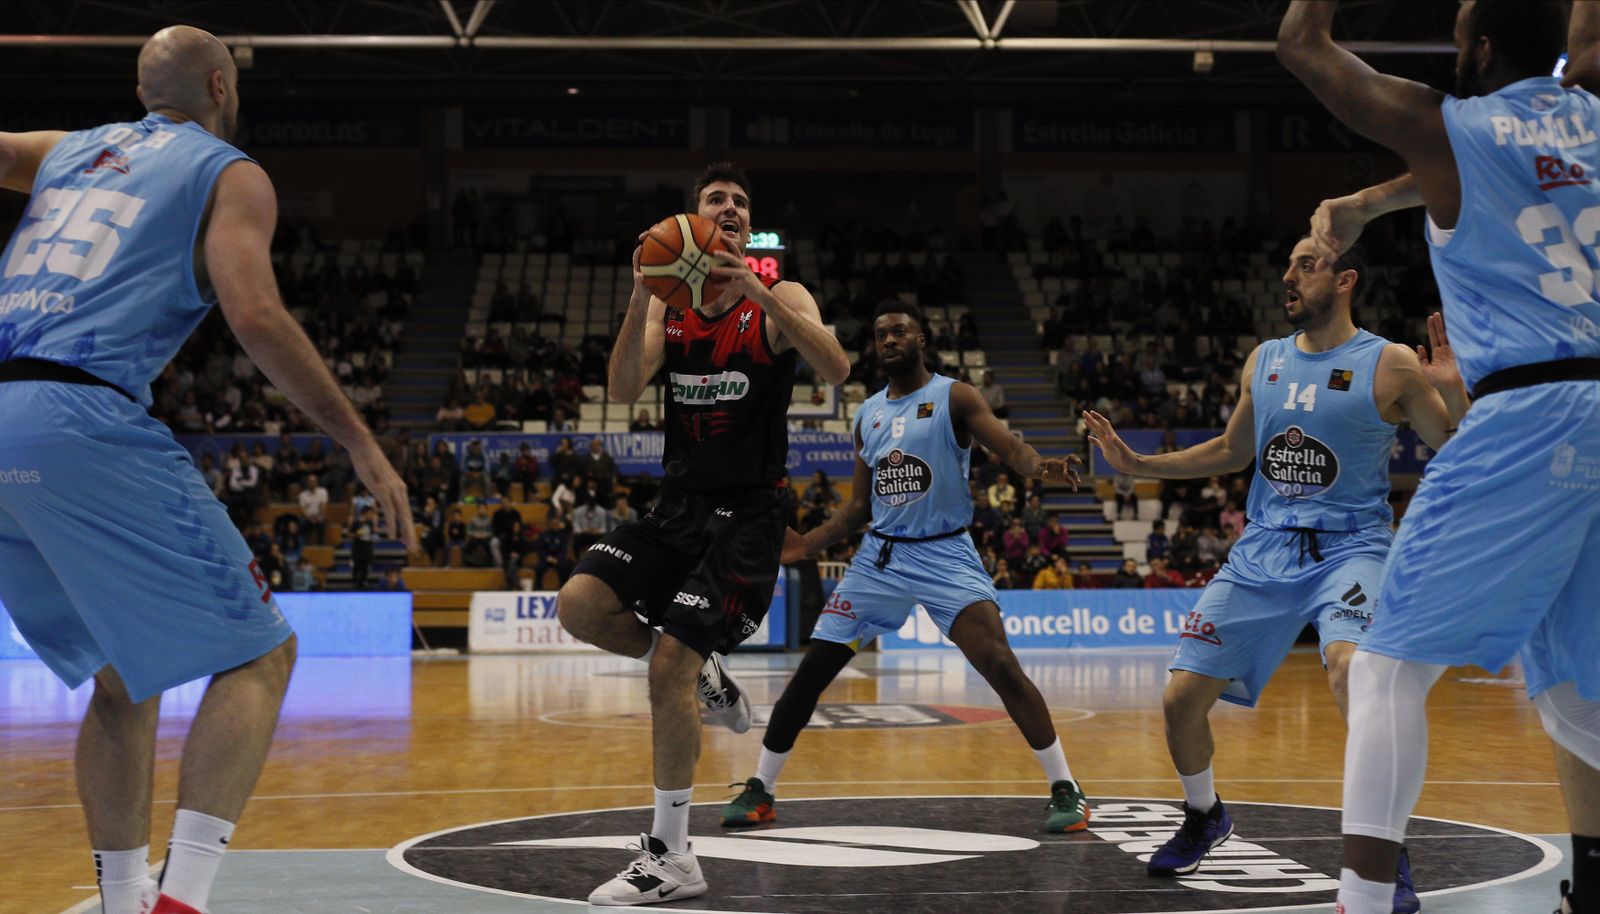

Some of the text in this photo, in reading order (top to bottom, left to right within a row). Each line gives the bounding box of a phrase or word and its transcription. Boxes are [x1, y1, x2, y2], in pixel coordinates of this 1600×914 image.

[468, 117, 684, 140] VITALDENT
[793, 119, 957, 146] Concello de Lugo
[1023, 119, 1198, 144] Estrella Galicia
[3, 187, 146, 282] 25
[1283, 382, 1318, 412] 14
[891, 416, 906, 438] 6
[1266, 445, 1327, 467] Estrella
[1268, 462, 1323, 485] Galicia
[877, 477, 922, 495] Galicia
[1000, 608, 1109, 635] oncello
[1118, 608, 1155, 635] de
